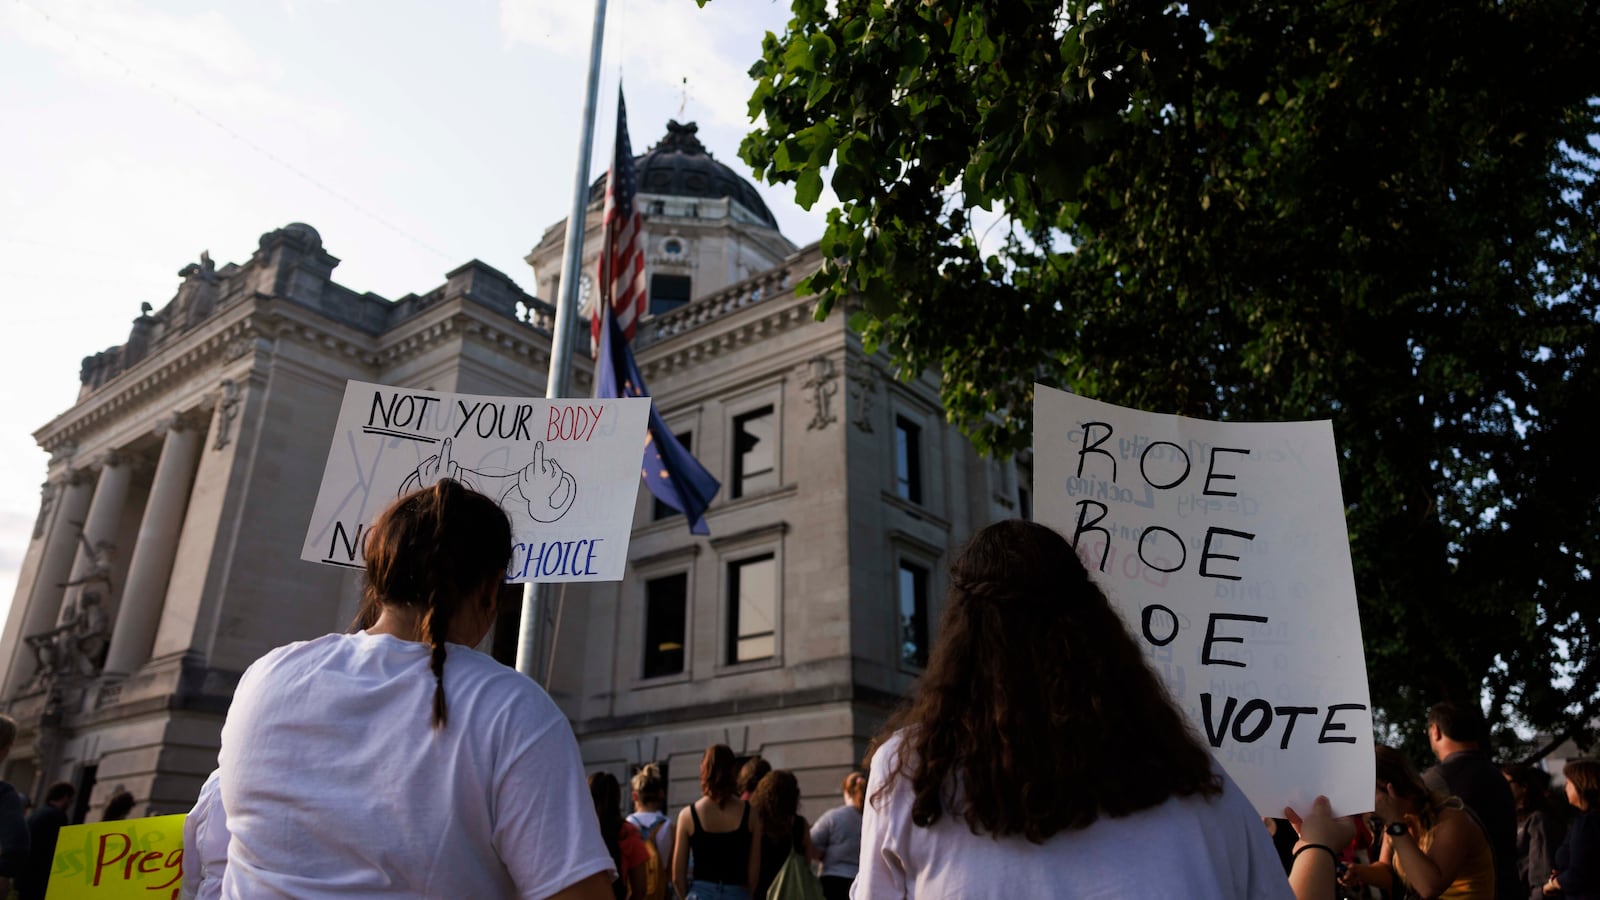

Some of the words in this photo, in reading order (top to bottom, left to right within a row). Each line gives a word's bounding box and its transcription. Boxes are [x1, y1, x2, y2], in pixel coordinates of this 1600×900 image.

[367, 391, 441, 431] NOT
[454, 400, 534, 441] YOUR
[546, 405, 604, 442] BODY
[1077, 421, 1251, 497] ROE
[507, 538, 604, 580] CHOICE
[1072, 499, 1256, 581] ROE
[1141, 603, 1269, 667] OE
[1199, 692, 1367, 750] VOTE
